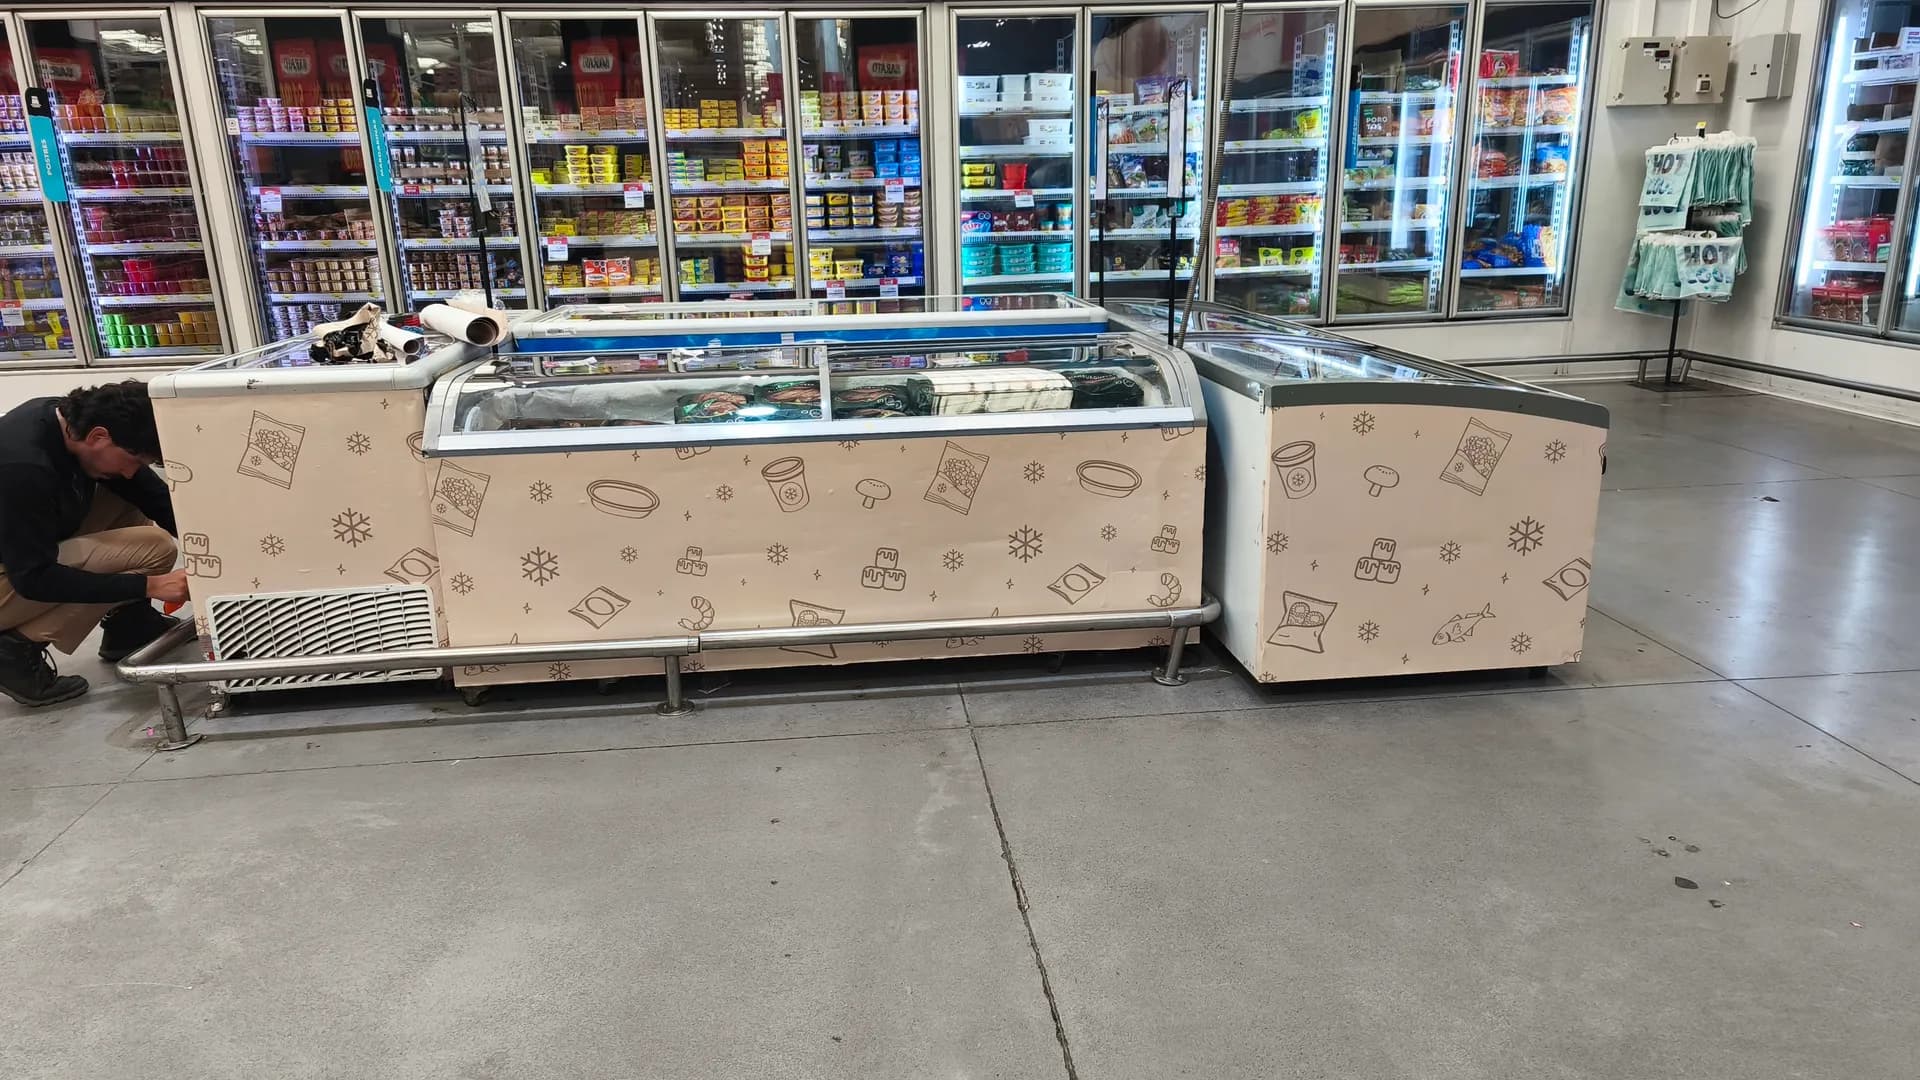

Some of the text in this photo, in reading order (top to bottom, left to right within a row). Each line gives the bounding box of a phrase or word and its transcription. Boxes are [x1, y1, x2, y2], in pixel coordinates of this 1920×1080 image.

[40, 138, 53, 176] POSTRES
[1652, 153, 1688, 175] HOT
[1684, 244, 1732, 266] HOT
